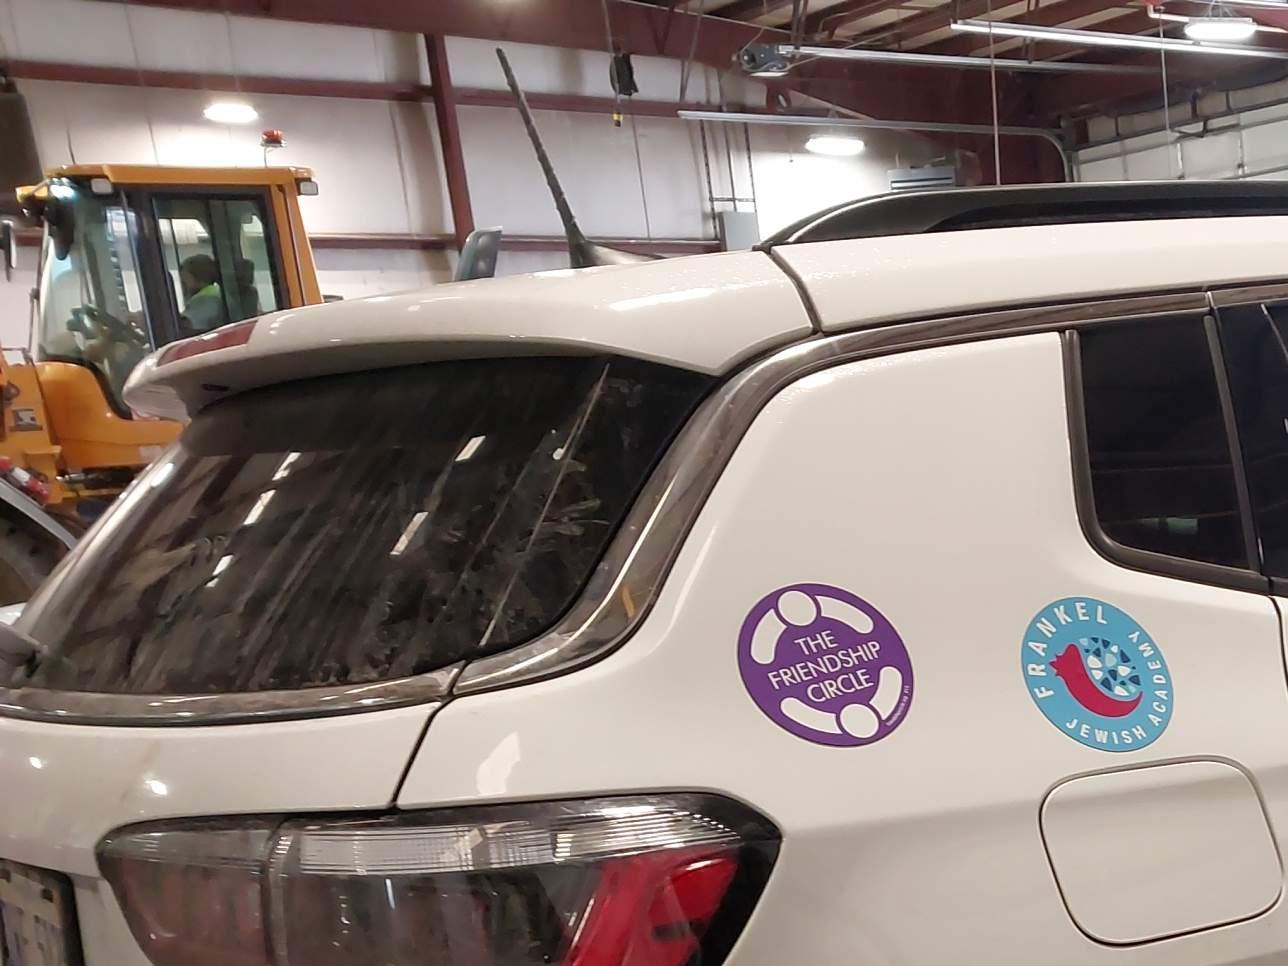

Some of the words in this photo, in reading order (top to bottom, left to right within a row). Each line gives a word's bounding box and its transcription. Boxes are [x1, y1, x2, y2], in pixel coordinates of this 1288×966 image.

[767, 641, 881, 690] FRIENDSHIP
[793, 630, 839, 655] THE
[1027, 602, 1107, 698] FRANKEL
[806, 669, 874, 702] CIRCLE
[1066, 718, 1147, 745] JEWISH
[1128, 631, 1169, 726] ACADEMY
